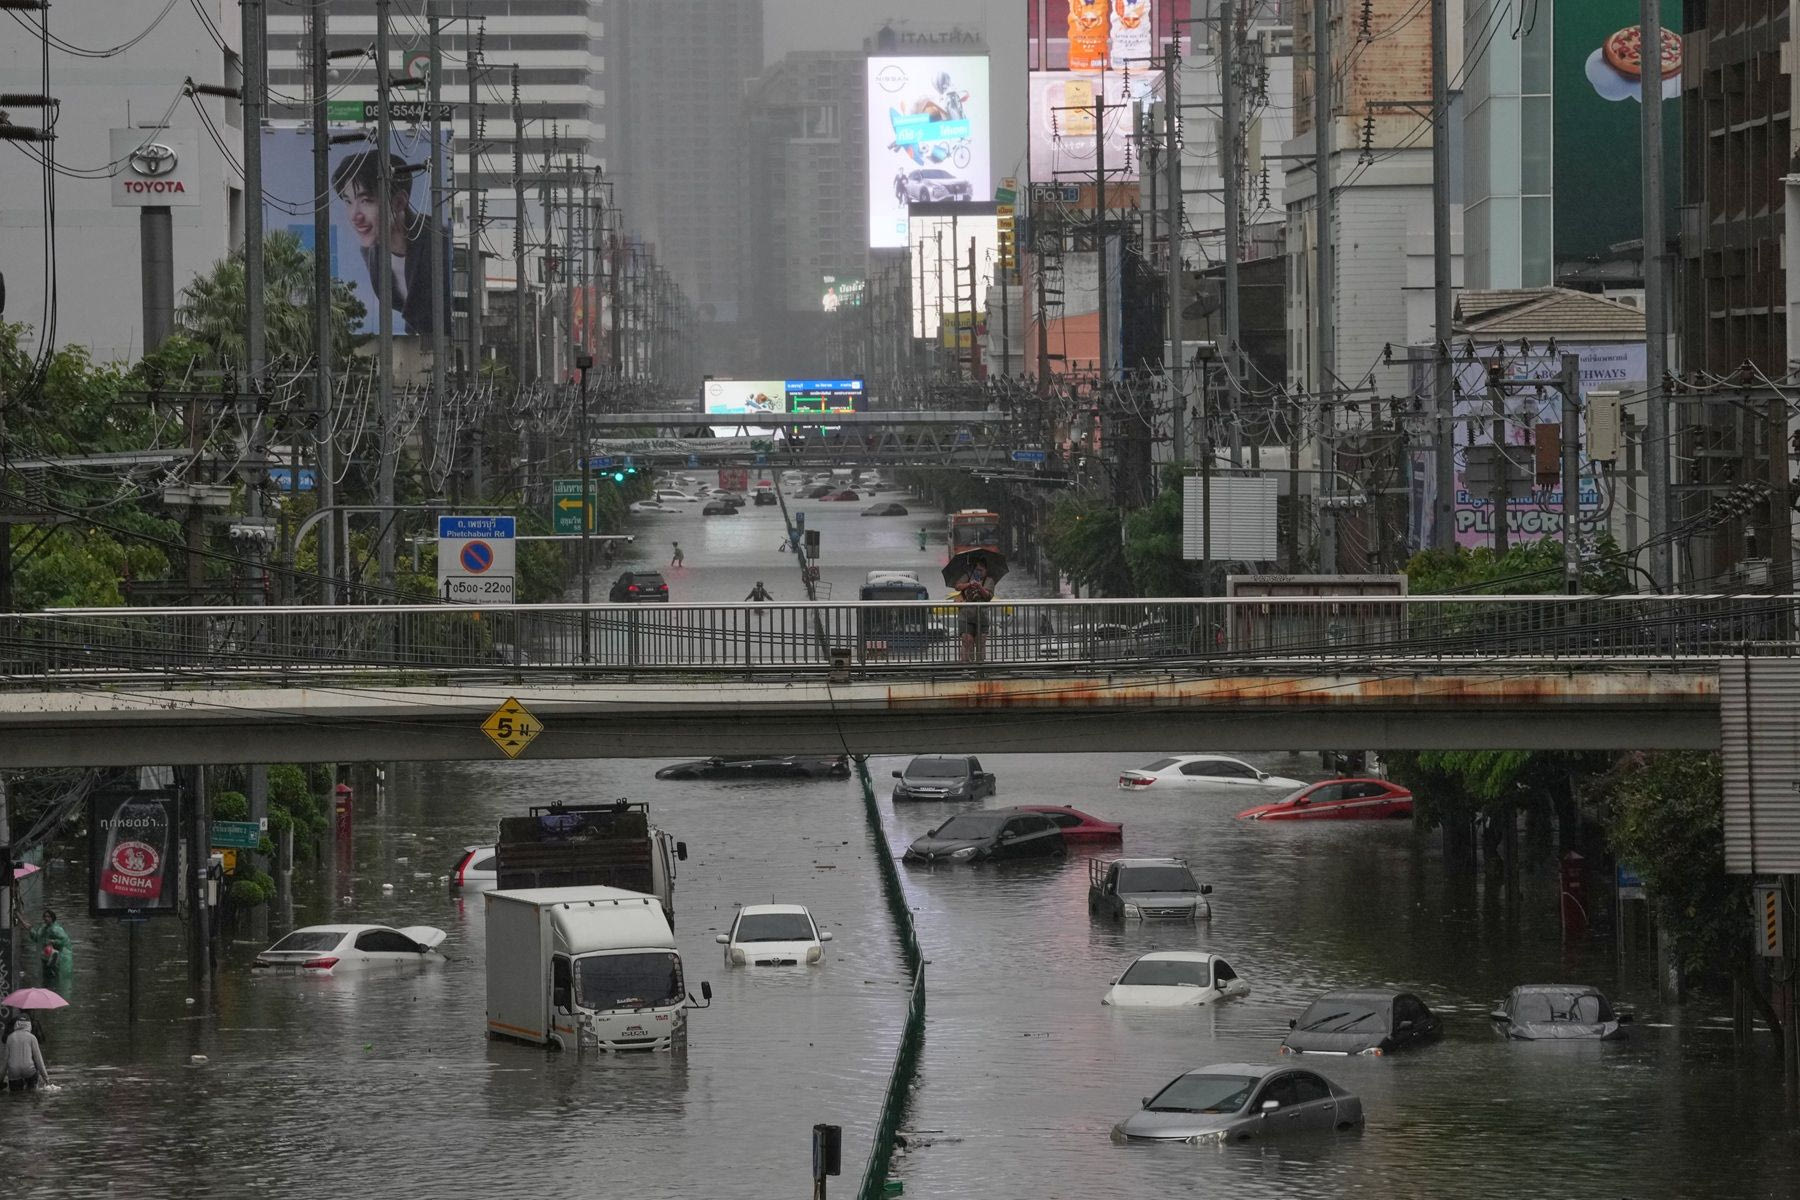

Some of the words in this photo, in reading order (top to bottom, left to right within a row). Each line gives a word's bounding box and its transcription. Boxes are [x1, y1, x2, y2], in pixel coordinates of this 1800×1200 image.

[901, 32, 980, 43] ITALTHAI
[124, 181, 185, 193] TOYOTA
[446, 530, 492, 538] Phetchaburi
[497, 717, 513, 739] 5
[111, 874, 153, 889] SINGHA
